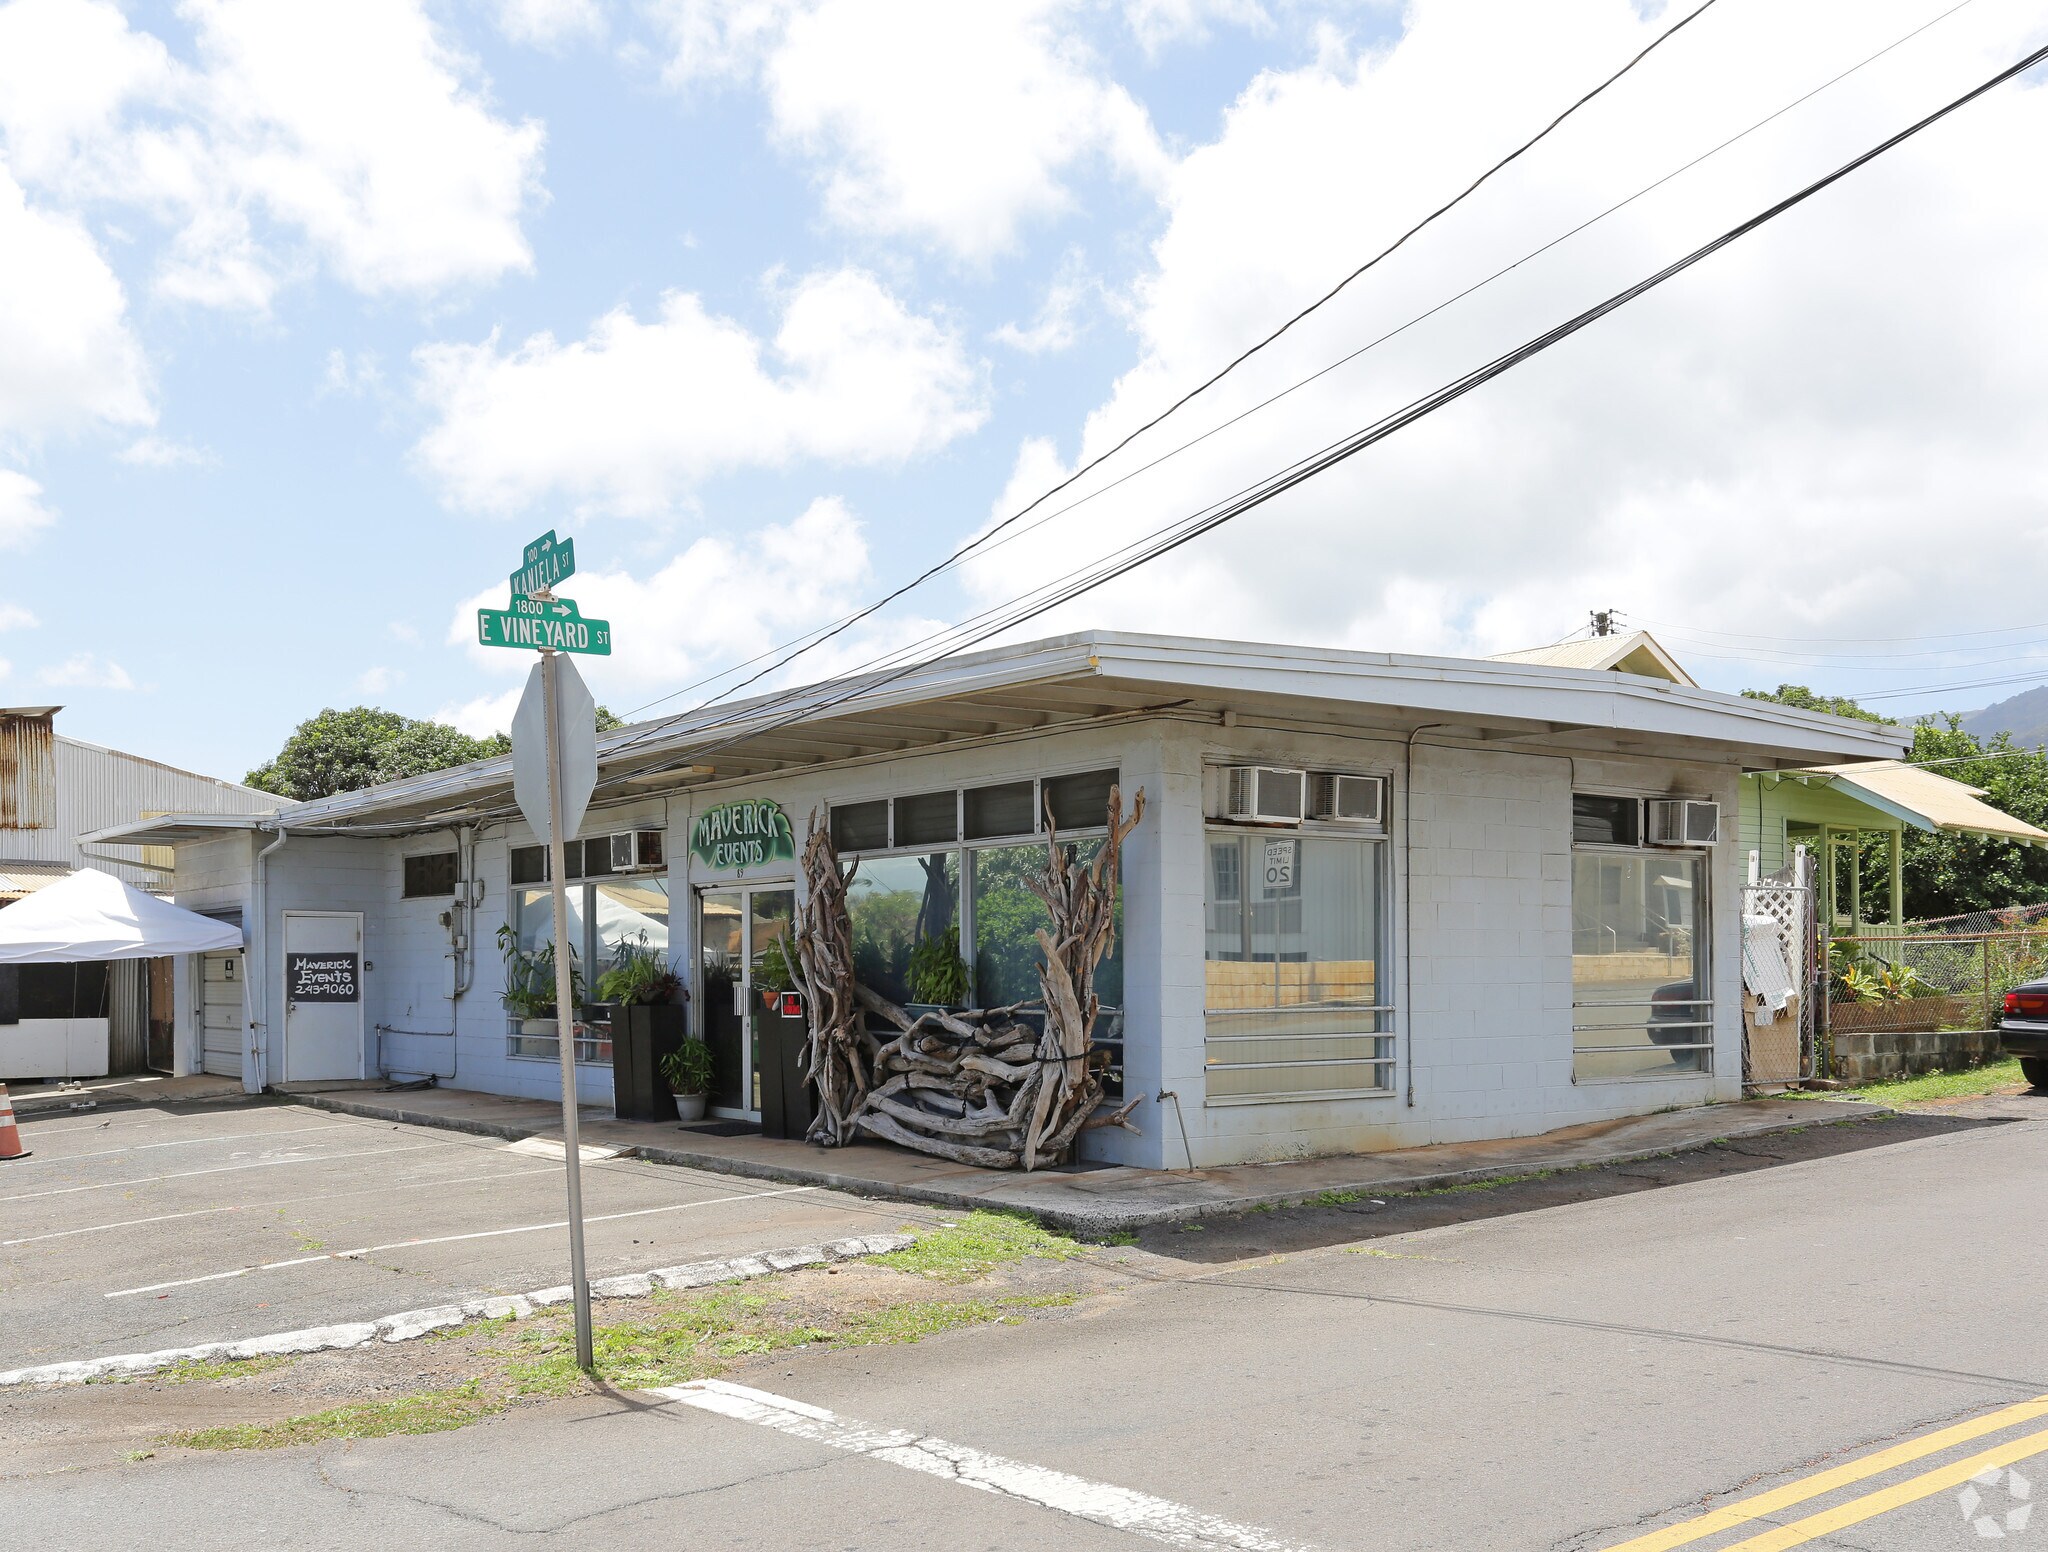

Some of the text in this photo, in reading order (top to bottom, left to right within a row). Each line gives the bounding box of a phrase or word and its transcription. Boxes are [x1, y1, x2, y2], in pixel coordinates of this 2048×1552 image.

[527, 546, 538, 563] 100
[514, 551, 570, 594] KANIELA ST
[515, 600, 543, 615] 1800
[480, 614, 609, 649] E VINEYARD ST
[699, 804, 779, 847] MAVERICK
[716, 839, 763, 865] EVENTS
[293, 957, 353, 970] MAVERICK
[294, 984, 354, 995] 243-9060
